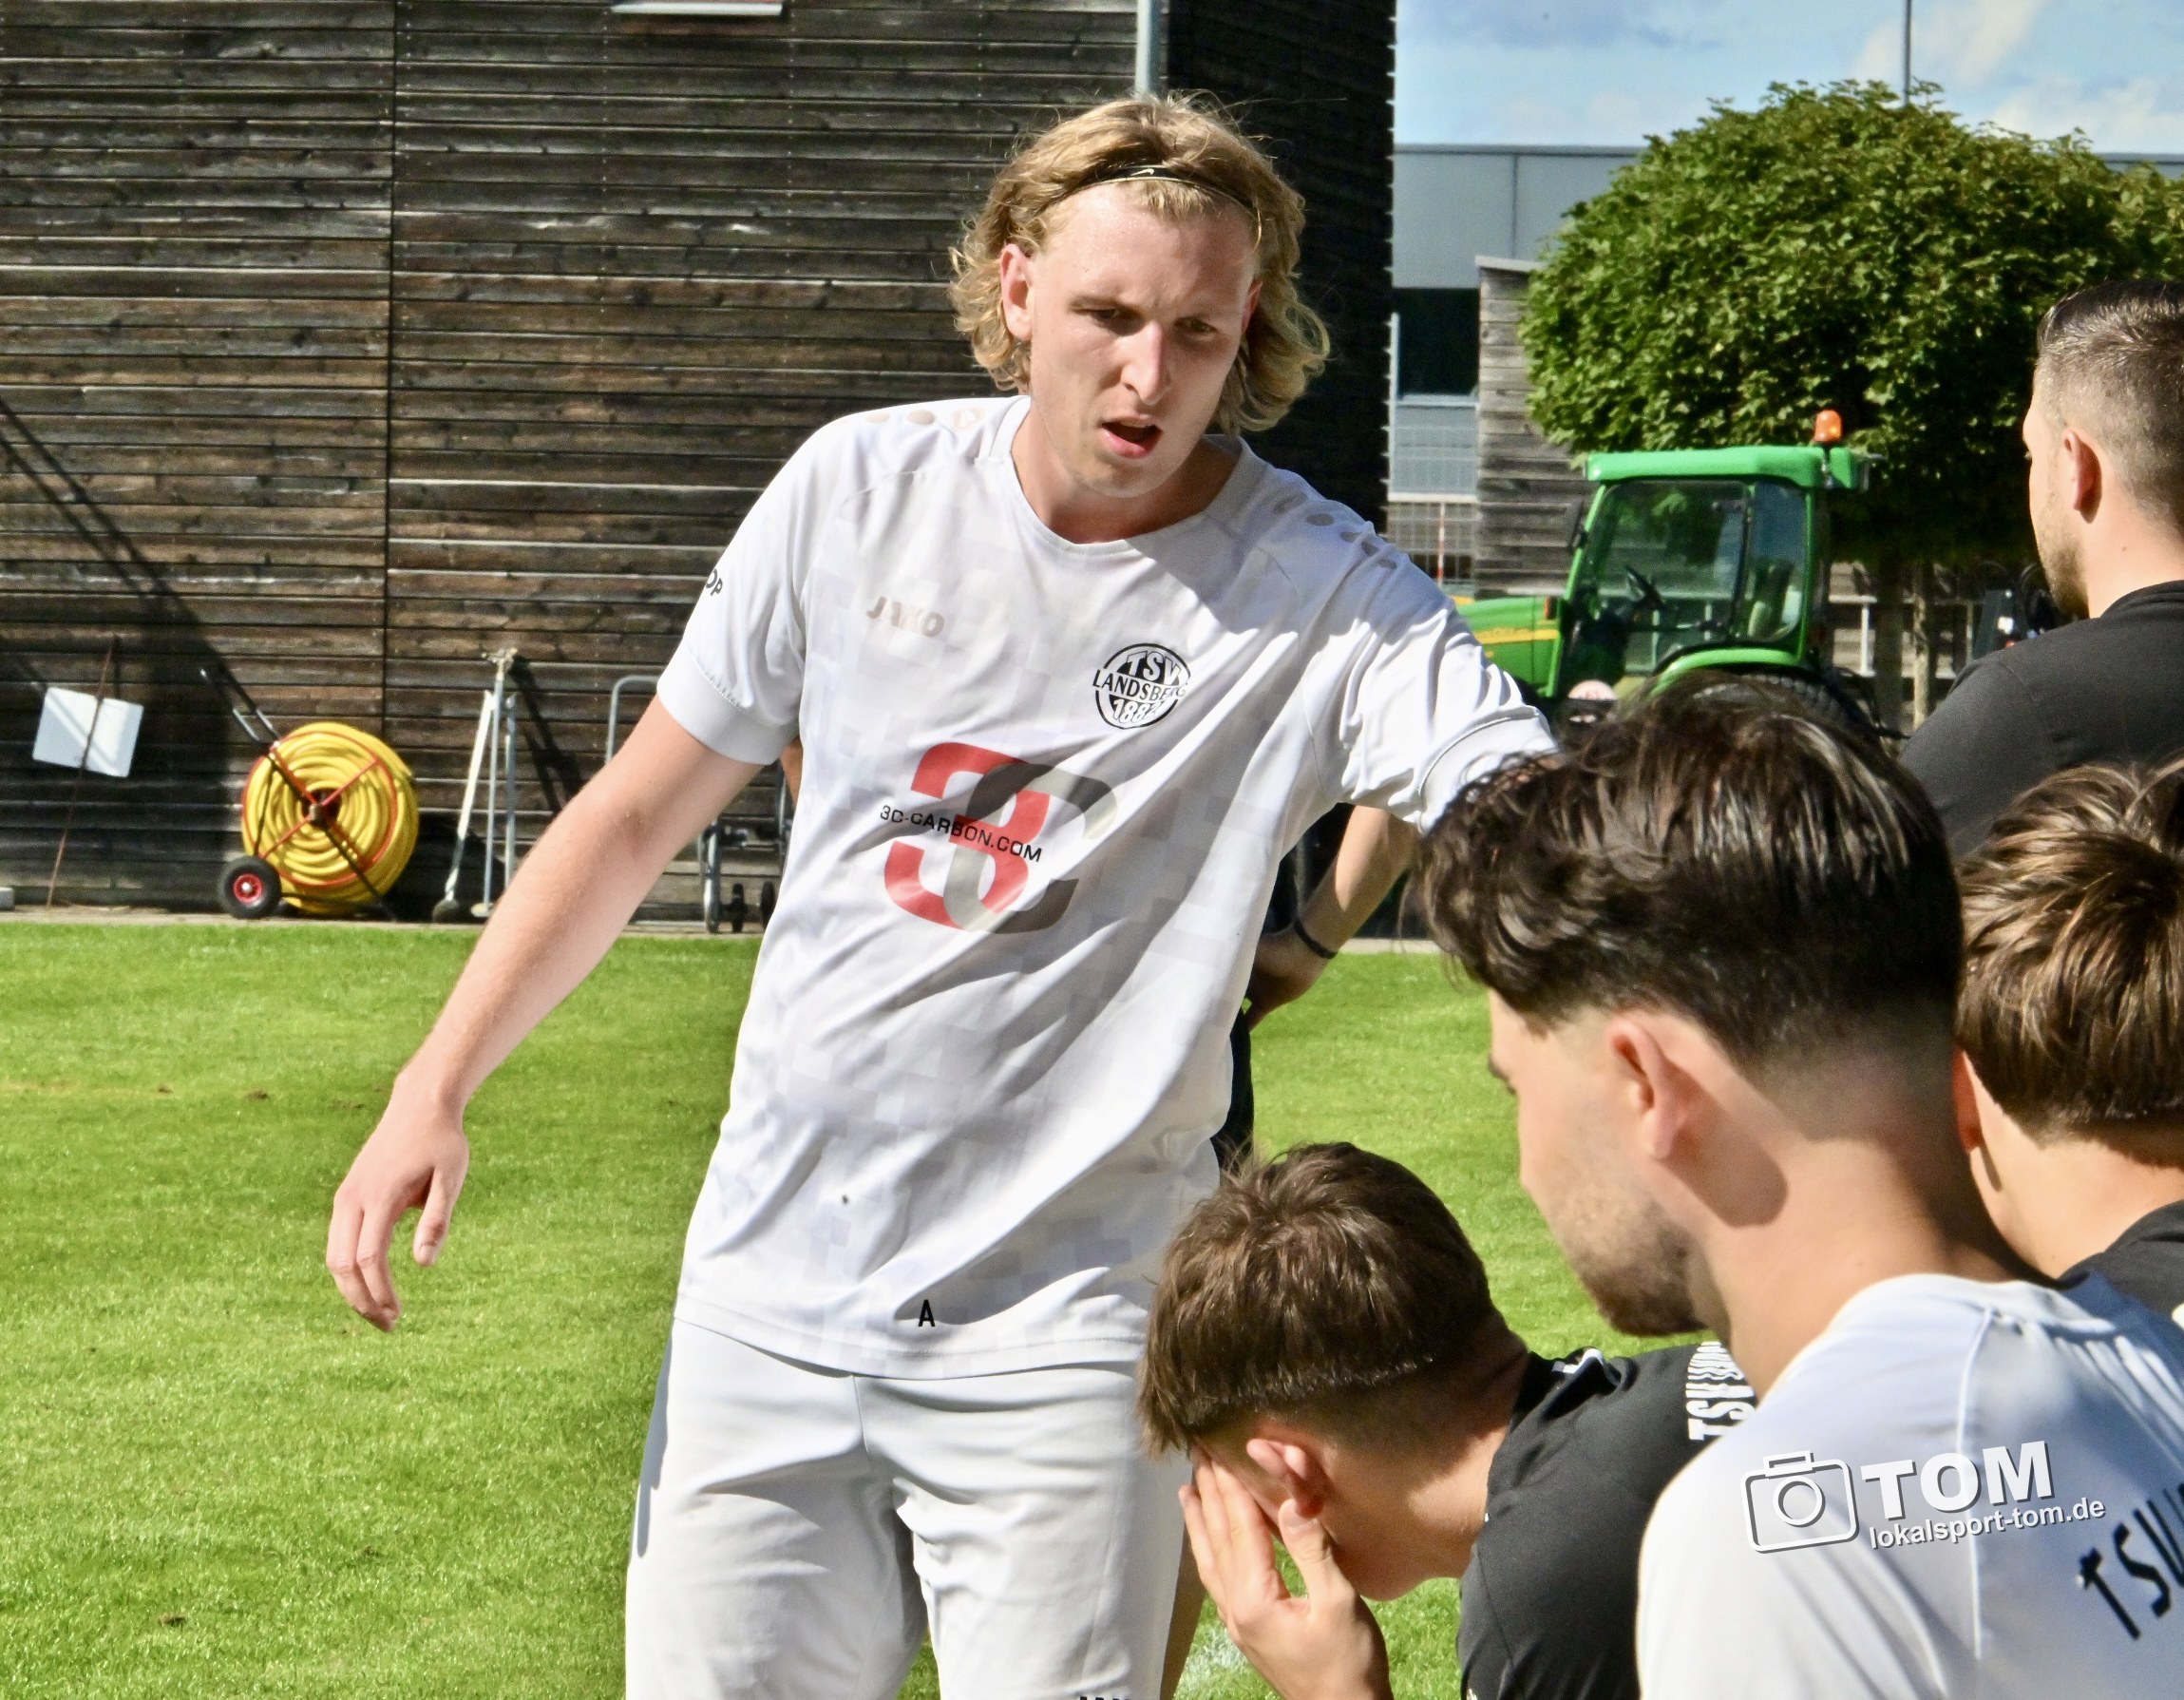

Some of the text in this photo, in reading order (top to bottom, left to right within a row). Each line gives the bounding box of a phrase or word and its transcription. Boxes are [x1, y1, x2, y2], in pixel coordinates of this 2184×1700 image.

[865, 596, 945, 638] JO
[1126, 650, 1182, 685] TSV
[880, 805, 1042, 863] 3C-CARBON.COM
[918, 1299, 936, 1327] A
[1685, 1381, 1757, 1442] TSV
[2079, 1499, 2184, 1641] TSV
